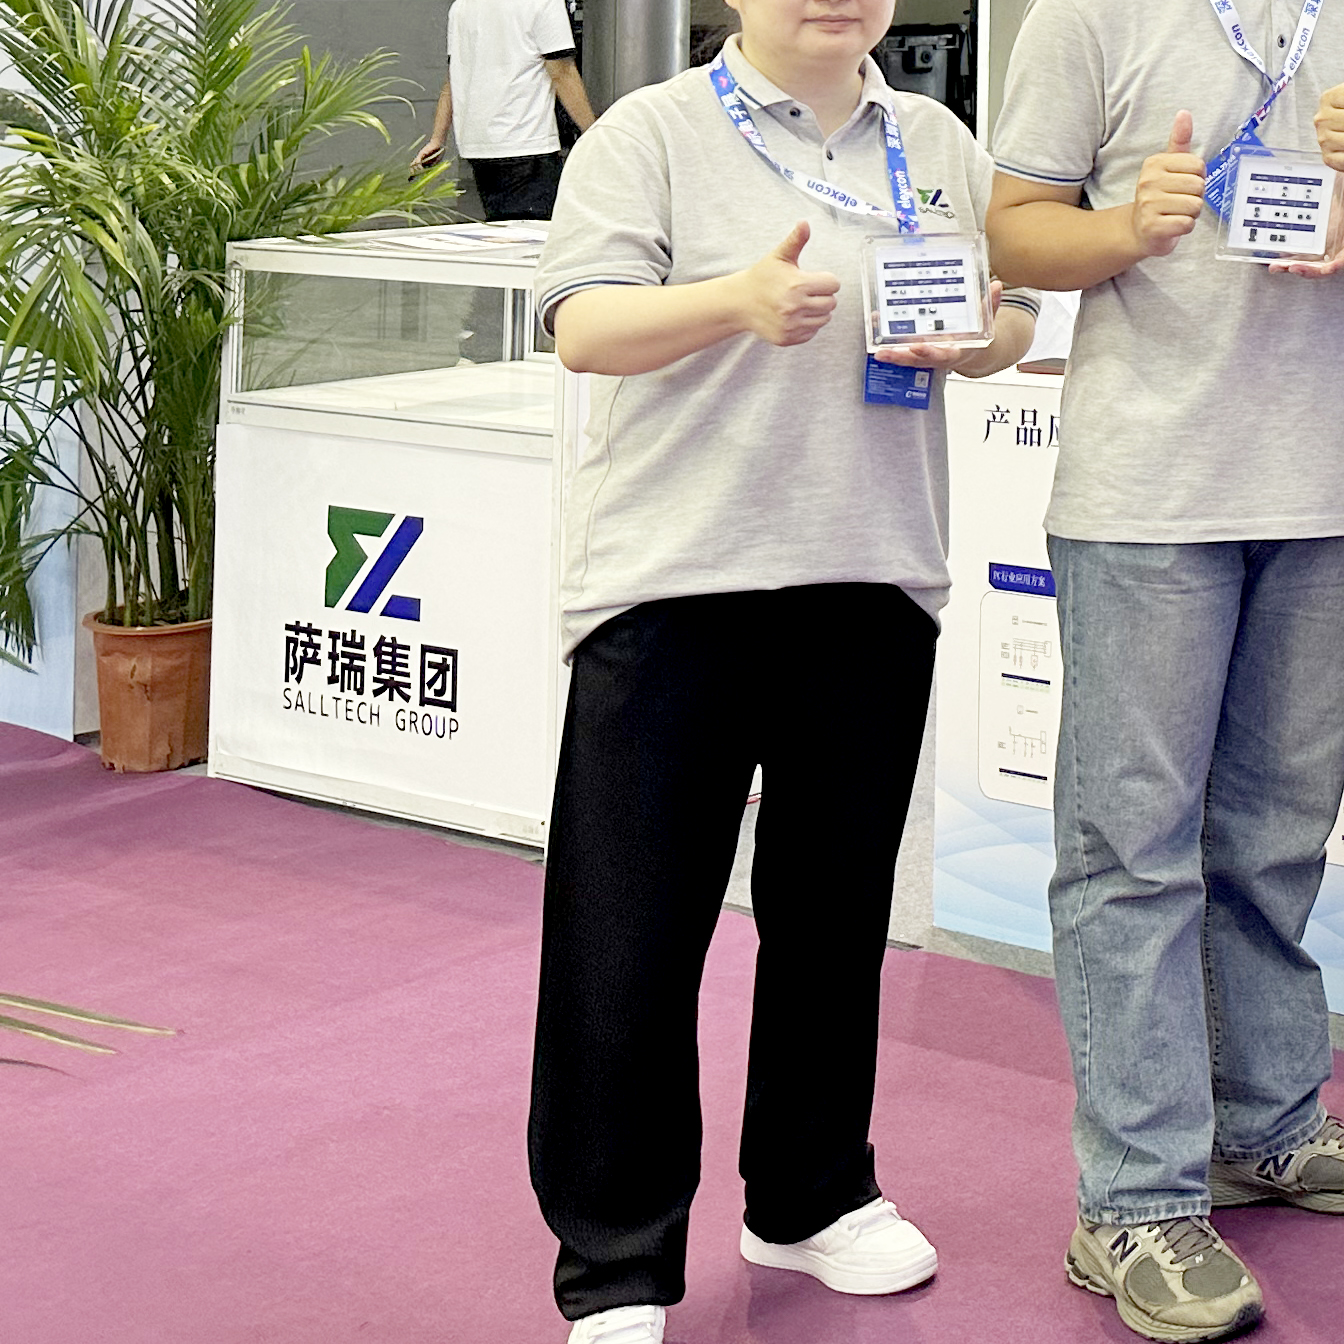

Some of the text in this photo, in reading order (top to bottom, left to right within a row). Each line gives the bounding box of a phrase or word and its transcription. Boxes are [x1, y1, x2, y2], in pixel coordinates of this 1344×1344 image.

[1290, 28, 1311, 71] elexcon
[807, 179, 858, 207] elexcon
[897, 170, 909, 209] elexcon
[283, 621, 458, 713] 萨瑞集团
[283, 688, 459, 741] SALLTECH GROUP
